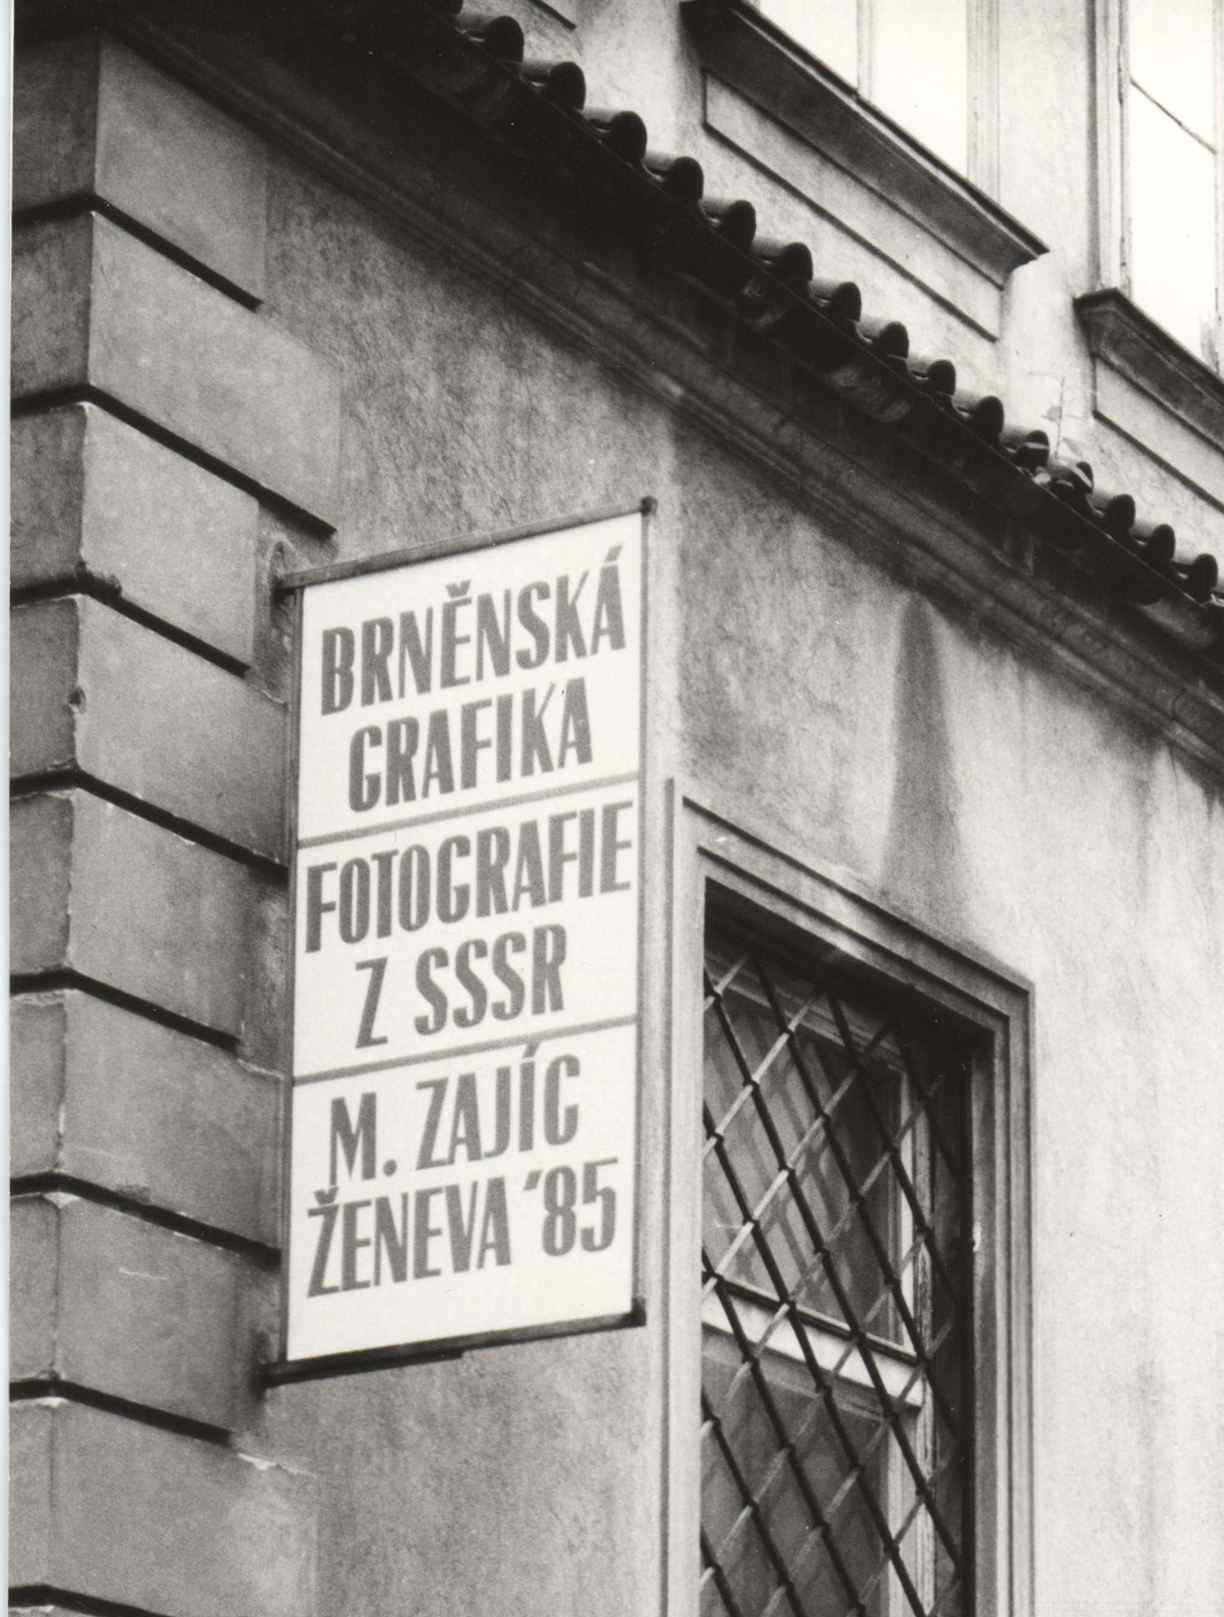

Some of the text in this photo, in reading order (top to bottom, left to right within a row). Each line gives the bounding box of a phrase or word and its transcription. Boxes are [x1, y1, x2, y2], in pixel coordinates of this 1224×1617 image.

[320, 545, 626, 717] BRNĚNSKÁ
[348, 677, 593, 813] GRAFIKA
[304, 800, 633, 955] FOTOGRAFIE
[354, 923, 567, 1049] Z SSSR
[330, 1043, 581, 1188] M. ZAJÍC
[306, 1176, 512, 1299] ŽENEVA
